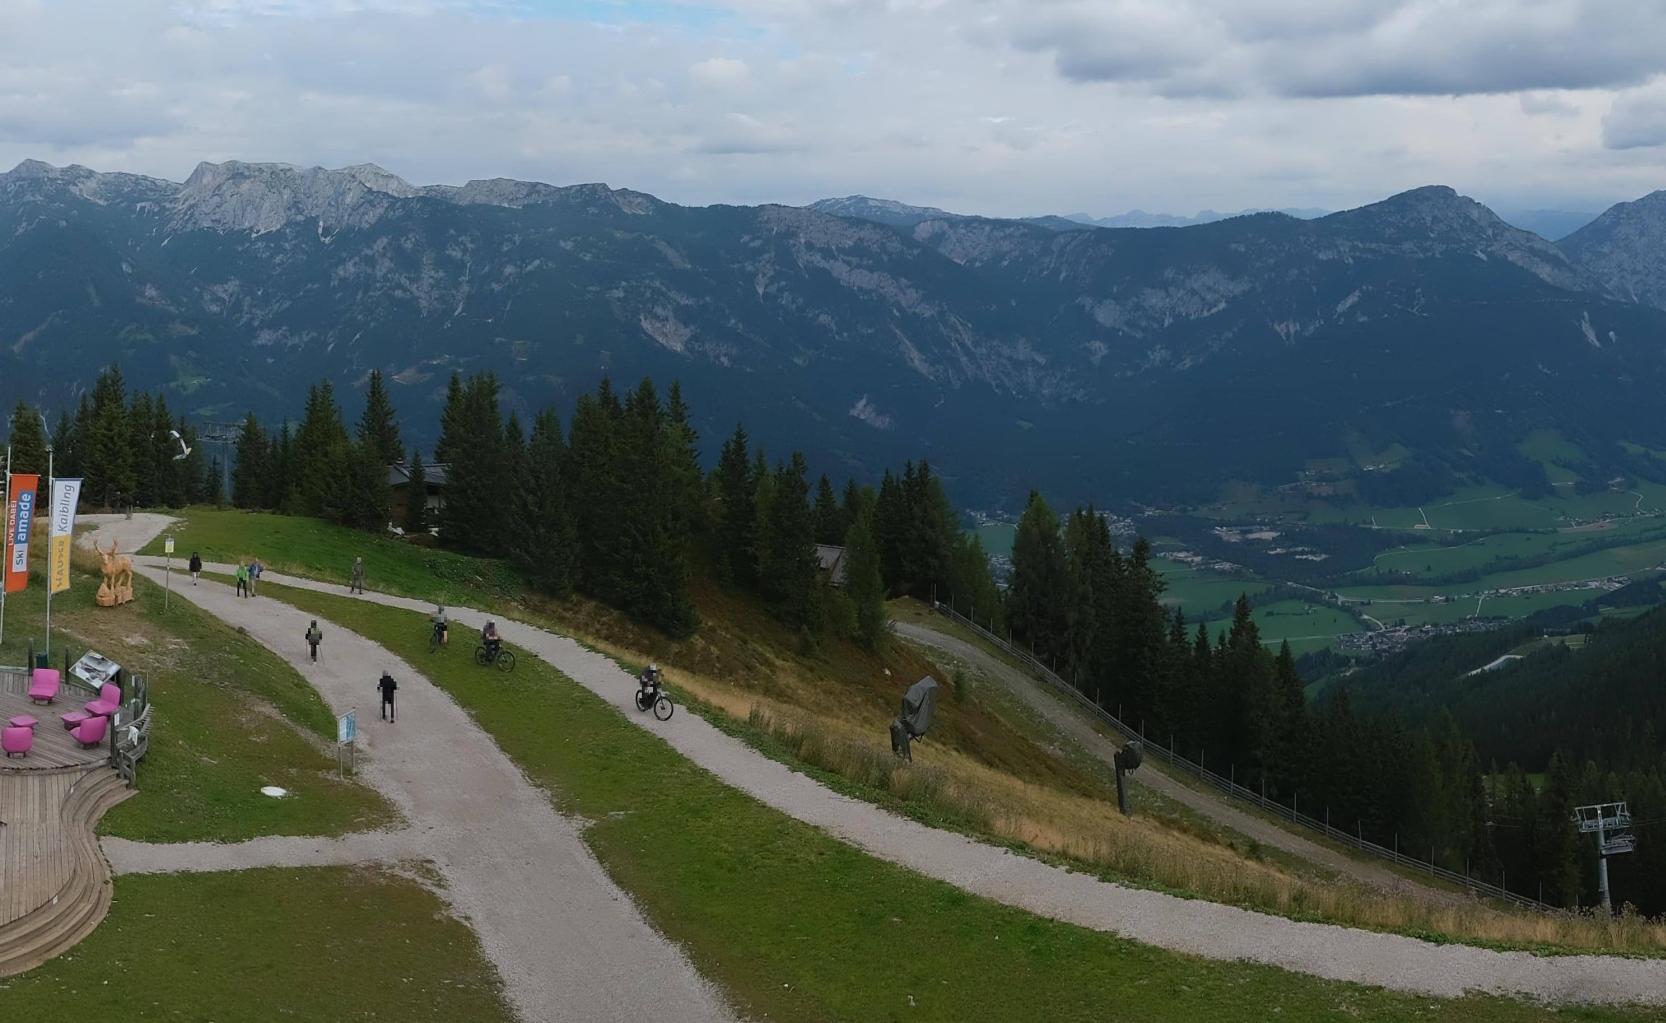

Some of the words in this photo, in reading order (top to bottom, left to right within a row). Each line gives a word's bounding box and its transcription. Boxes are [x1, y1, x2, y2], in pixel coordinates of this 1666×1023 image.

[9, 500, 18, 526] DABEI
[17, 493, 32, 541] amade
[57, 484, 75, 533] Kaibling
[16, 550, 24, 566] Ski
